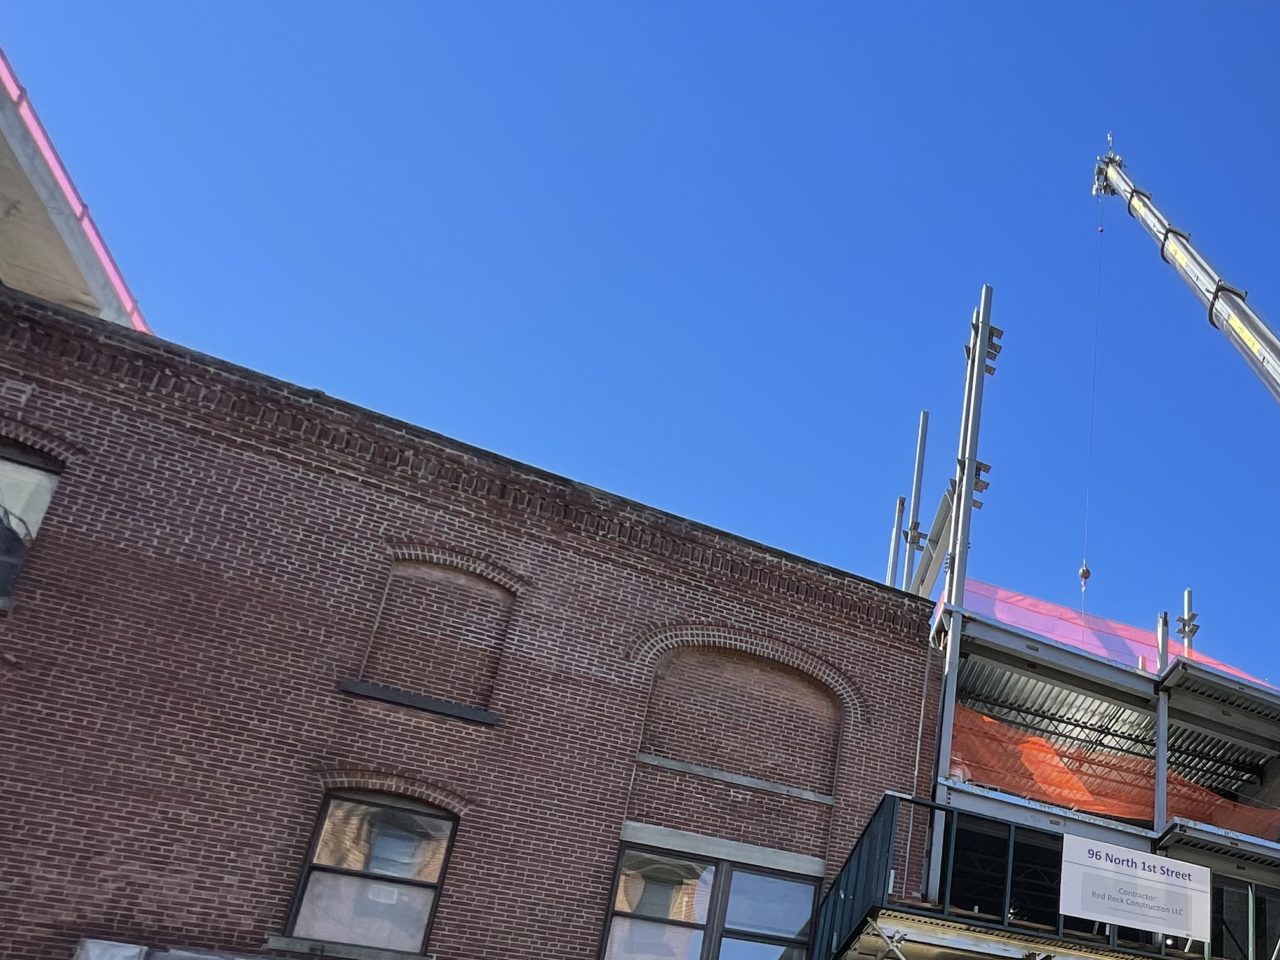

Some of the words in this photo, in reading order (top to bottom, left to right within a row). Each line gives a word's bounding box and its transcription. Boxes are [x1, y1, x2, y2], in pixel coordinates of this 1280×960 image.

[1087, 849, 1102, 860] 96
[1105, 853, 1137, 869] North
[1141, 862, 1157, 874] 1st
[1159, 865, 1193, 882] Street
[1118, 887, 1158, 902] Contractor:
[1107, 895, 1124, 904] Rock
[1125, 898, 1170, 914] Construction
[1171, 908, 1184, 916] LLC
